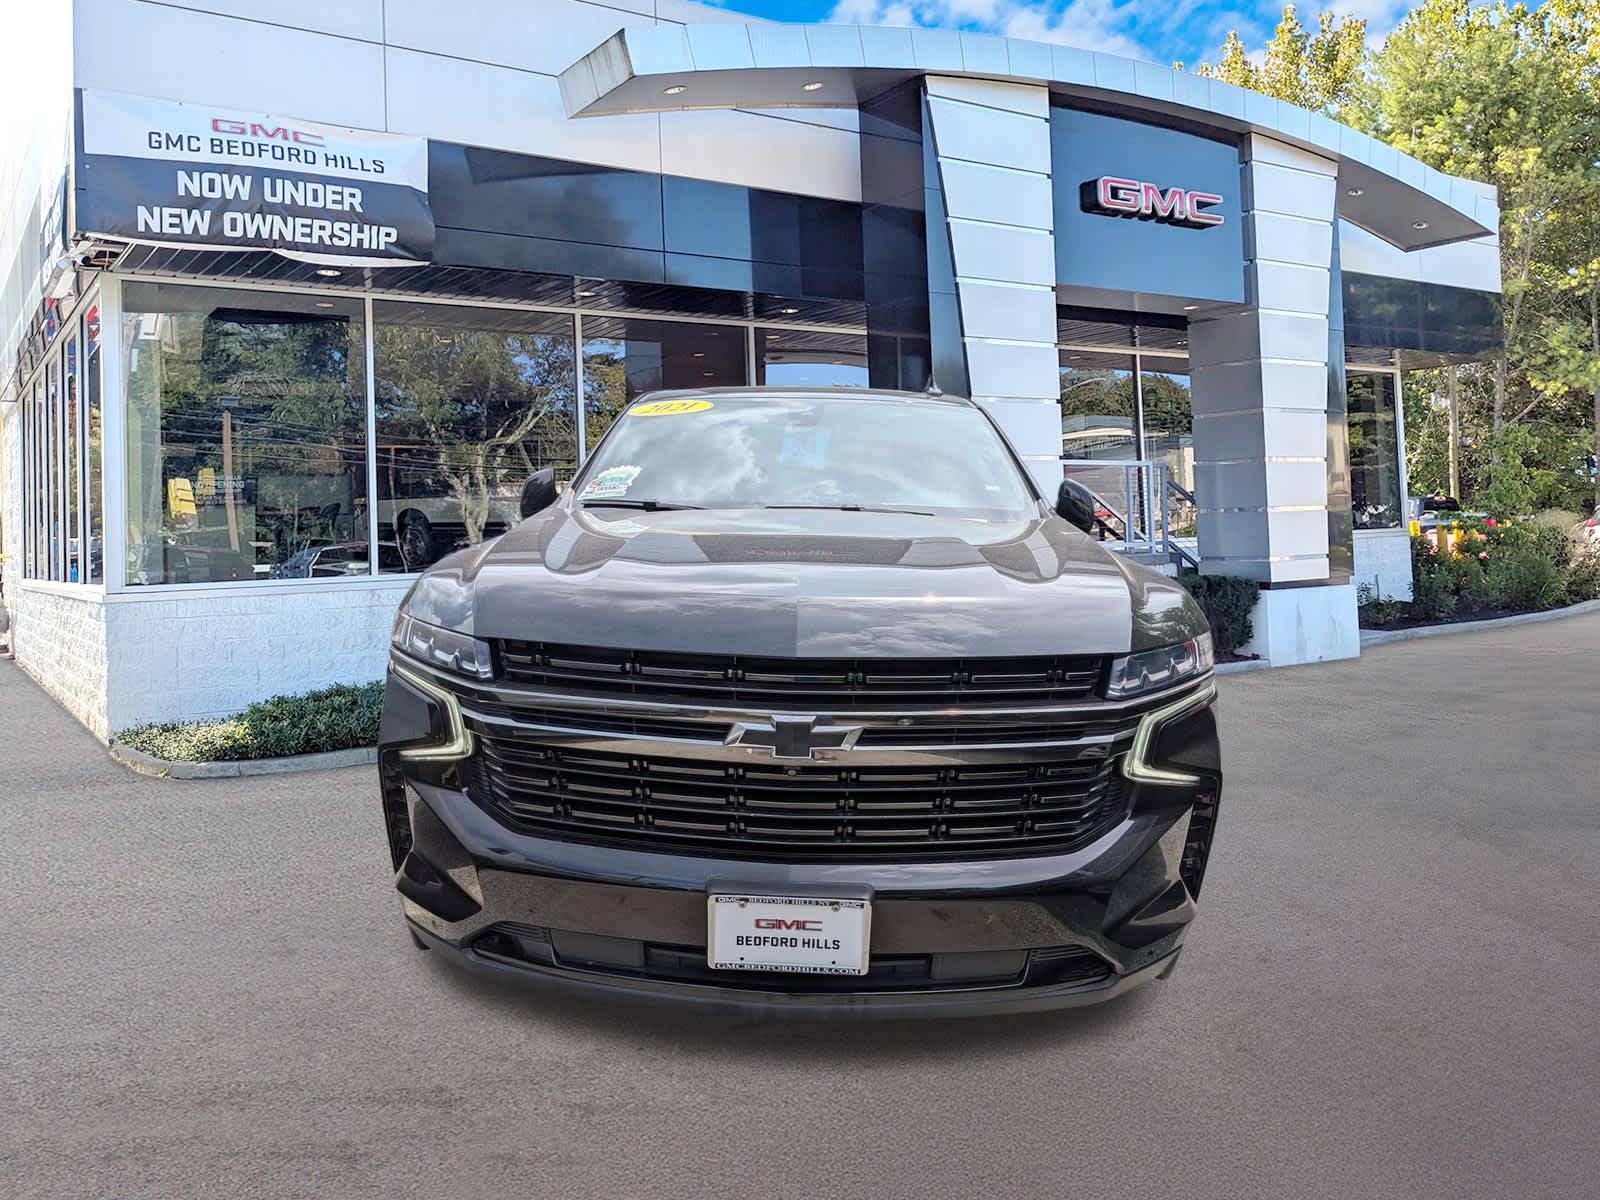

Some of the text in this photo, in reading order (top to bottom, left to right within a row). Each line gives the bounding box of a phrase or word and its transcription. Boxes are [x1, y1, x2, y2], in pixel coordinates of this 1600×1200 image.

[148, 131, 385, 174] GMC BEDFORD HILLS
[211, 118, 326, 148] GMC
[177, 169, 364, 213] NOW UNDER
[1096, 176, 1224, 225] GMC
[136, 205, 398, 250] NEW OWNERSHIP
[736, 935, 841, 951] BEDFORD HILLS
[754, 918, 824, 932] GMC
